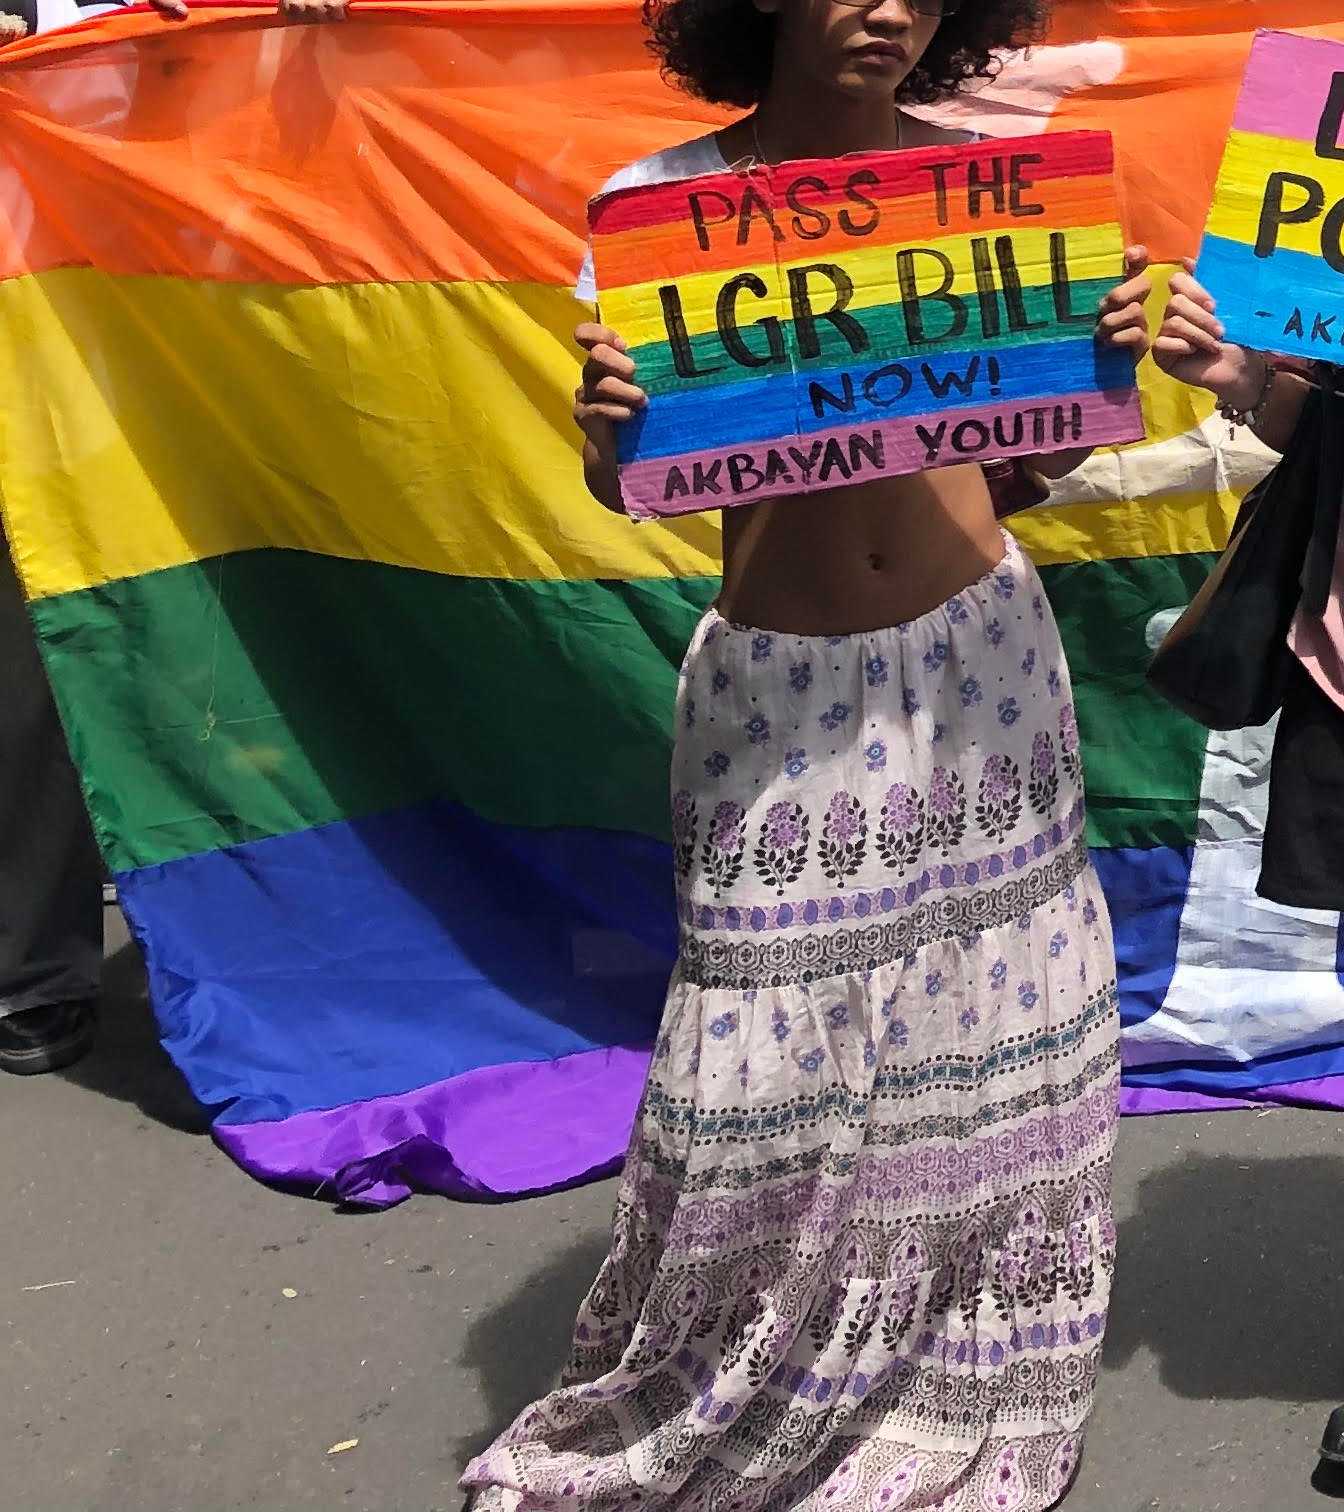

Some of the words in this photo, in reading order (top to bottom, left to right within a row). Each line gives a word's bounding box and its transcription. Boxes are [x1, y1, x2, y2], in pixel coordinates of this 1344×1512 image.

[687, 168, 882, 253] PASS
[926, 153, 1045, 227] THE
[658, 263, 870, 380] LGR
[895, 231, 1097, 348] BILL
[808, 356, 1000, 419] NOW!
[663, 428, 885, 502] AKBAYAN
[915, 402, 1083, 461] YOUTH
